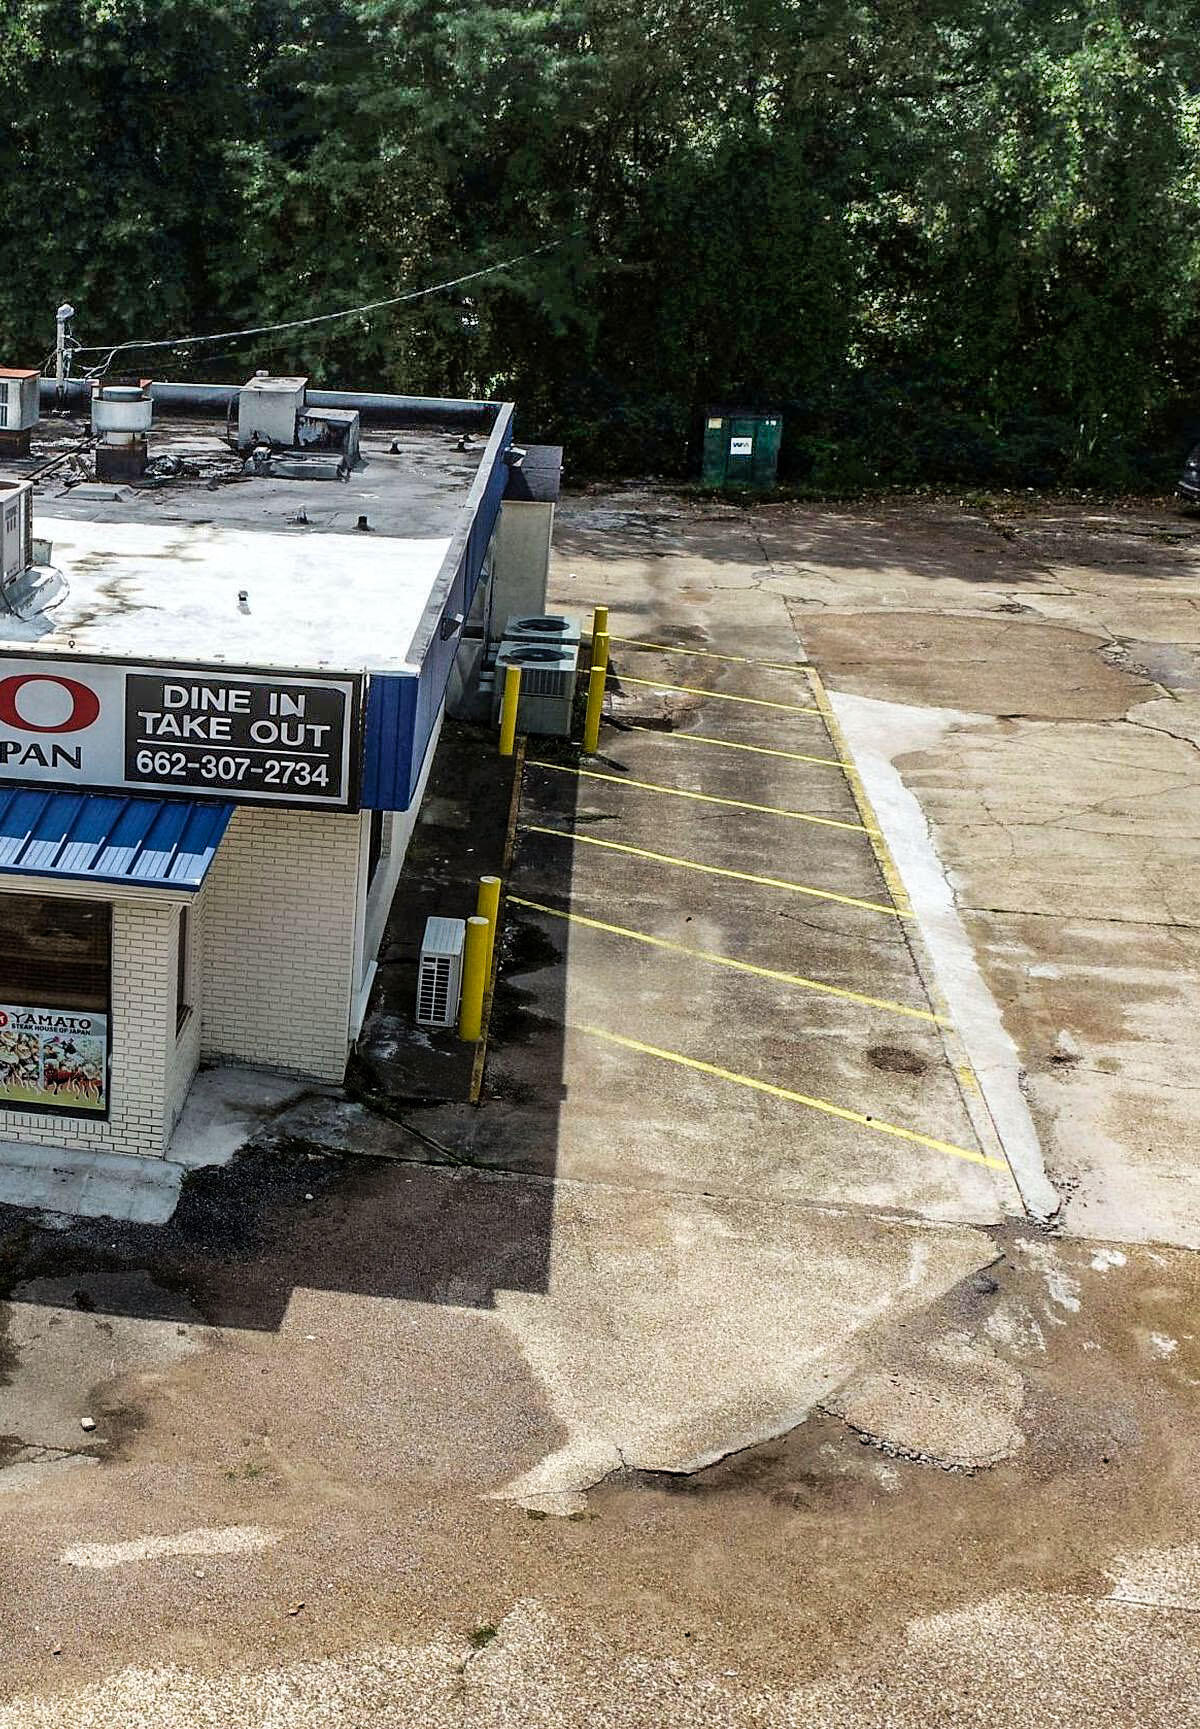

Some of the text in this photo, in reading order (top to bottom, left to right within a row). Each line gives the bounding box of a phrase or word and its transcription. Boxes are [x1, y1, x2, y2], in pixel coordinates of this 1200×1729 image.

[163, 684, 306, 718] DINE IN
[137, 711, 331, 748] TAKE OUT
[136, 749, 330, 787] 662-307-2734
[10, 1011, 92, 1030] YAMATO
[11, 1022, 34, 1030] STEAK
[69, 1028, 91, 1036] JAPAN
